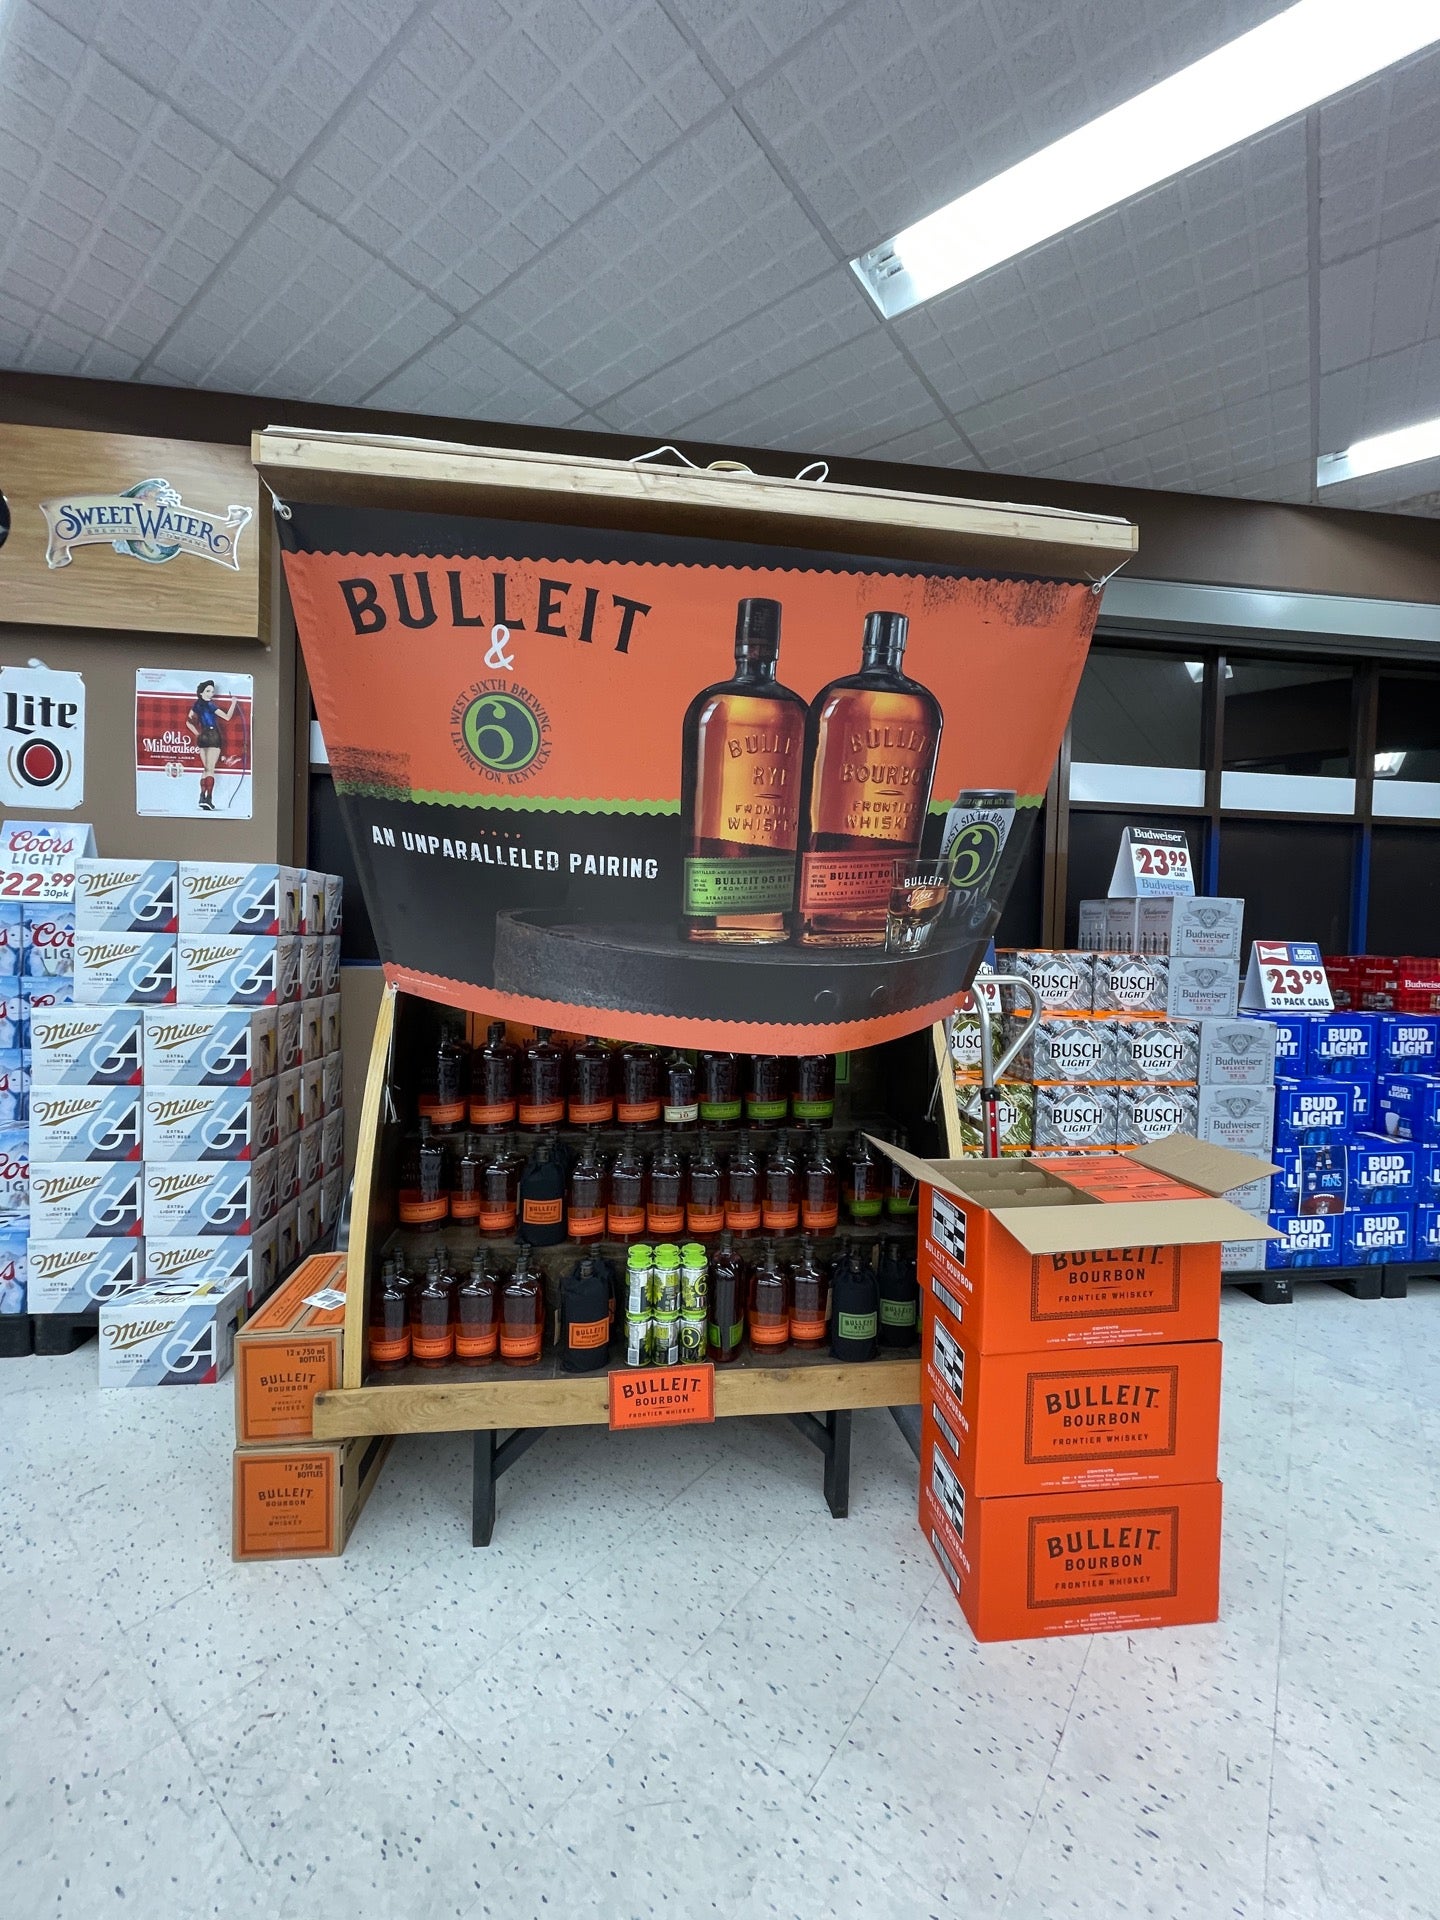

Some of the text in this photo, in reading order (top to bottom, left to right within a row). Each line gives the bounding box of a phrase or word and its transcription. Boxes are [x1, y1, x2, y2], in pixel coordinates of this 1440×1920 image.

[56, 503, 230, 554] SweetWater
[338, 570, 652, 653] BULLEIT
[484, 624, 514, 671] &
[450, 679, 551, 732] WEST SIXTH BREWING
[3, 692, 78, 735] Lite
[163, 731, 191, 744] Old
[465, 695, 539, 769] 6
[143, 736, 200, 754] Milwaukee
[508, 739, 552, 784] KENTUCKY
[9, 831, 73, 853] Coors
[1134, 829, 1182, 841] Budweiser
[12, 853, 65, 866] LIGHT
[372, 826, 658, 879] AN UNPARALLELED PAIRING
[949, 824, 999, 888] 6
[715, 877, 759, 885] BULLEIT
[830, 871, 874, 880] BULLEIT
[905, 876, 943, 888] BULLEIT
[1142, 879, 1189, 891] Budweiser
[44, 890, 69, 898] 30pk
[78, 872, 177, 921] Miller 64
[182, 875, 279, 923] Miller 64
[1185, 929, 1230, 939] Budweiser
[77, 944, 176, 992] Miller 64
[181, 946, 277, 994] Miller 64
[1031, 975, 1078, 990] BUSCH
[1110, 976, 1155, 991] BUSCH
[1182, 990, 1227, 999] Budweiser
[1284, 998, 1305, 1006] PACK
[1328, 1029, 1362, 1041] BUD
[1398, 1028, 1428, 1041] BUD
[33, 1022, 141, 1073] Miller 64
[147, 1023, 251, 1075] Miller 64
[1051, 1044, 1101, 1059] BUSCH
[1133, 1045, 1183, 1060] BUSCH
[1321, 1042, 1368, 1055] LIGHT
[1392, 1042, 1433, 1055] LIGHT
[1215, 1057, 1262, 1066] Budweiser
[1301, 1097, 1337, 1111] BUD
[1053, 1109, 1102, 1124] BUSCH
[1134, 1108, 1182, 1123] BUSCH
[1293, 1111, 1344, 1125] LIGHT
[33, 1099, 141, 1150] Miller 64
[147, 1099, 251, 1149] Miller 64
[1063, 1125, 1091, 1133] LIGHT
[1213, 1120, 1261, 1130] Budweiser
[1368, 1156, 1404, 1170] BUD
[1361, 1170, 1410, 1184] LIGHT
[33, 1175, 141, 1226] Miller 64
[148, 1174, 250, 1225] Miller 64
[1289, 1220, 1325, 1234] BUD
[1364, 1217, 1399, 1231] BUD
[1281, 1234, 1331, 1248] LIGHT
[1357, 1231, 1405, 1246] LIGHT
[149, 1248, 215, 1270] Miller
[926, 1239, 945, 1264] BULLEIT
[946, 1260, 972, 1293] BOURBON
[30, 1251, 137, 1300] Miller 64
[1070, 1269, 1145, 1284] BOURBON
[1059, 1291, 1153, 1302] FRONTIER WHISKEY
[103, 1320, 216, 1373] Miller 64
[260, 1373, 316, 1386] BULLEIT
[623, 1378, 701, 1398] BULLEIT
[636, 1395, 688, 1406] BOURBON
[1045, 1385, 1159, 1415] BULLEIT
[1064, 1412, 1140, 1427] BOURBON
[1053, 1434, 1148, 1445] FRONTIER WHISKEY
[258, 1488, 313, 1500] BULLEIT
[1047, 1528, 1161, 1558] BULLEIT
[1066, 1554, 1142, 1571] BOURBON
[1055, 1576, 1150, 1590] FRONTIER WHISKEY
